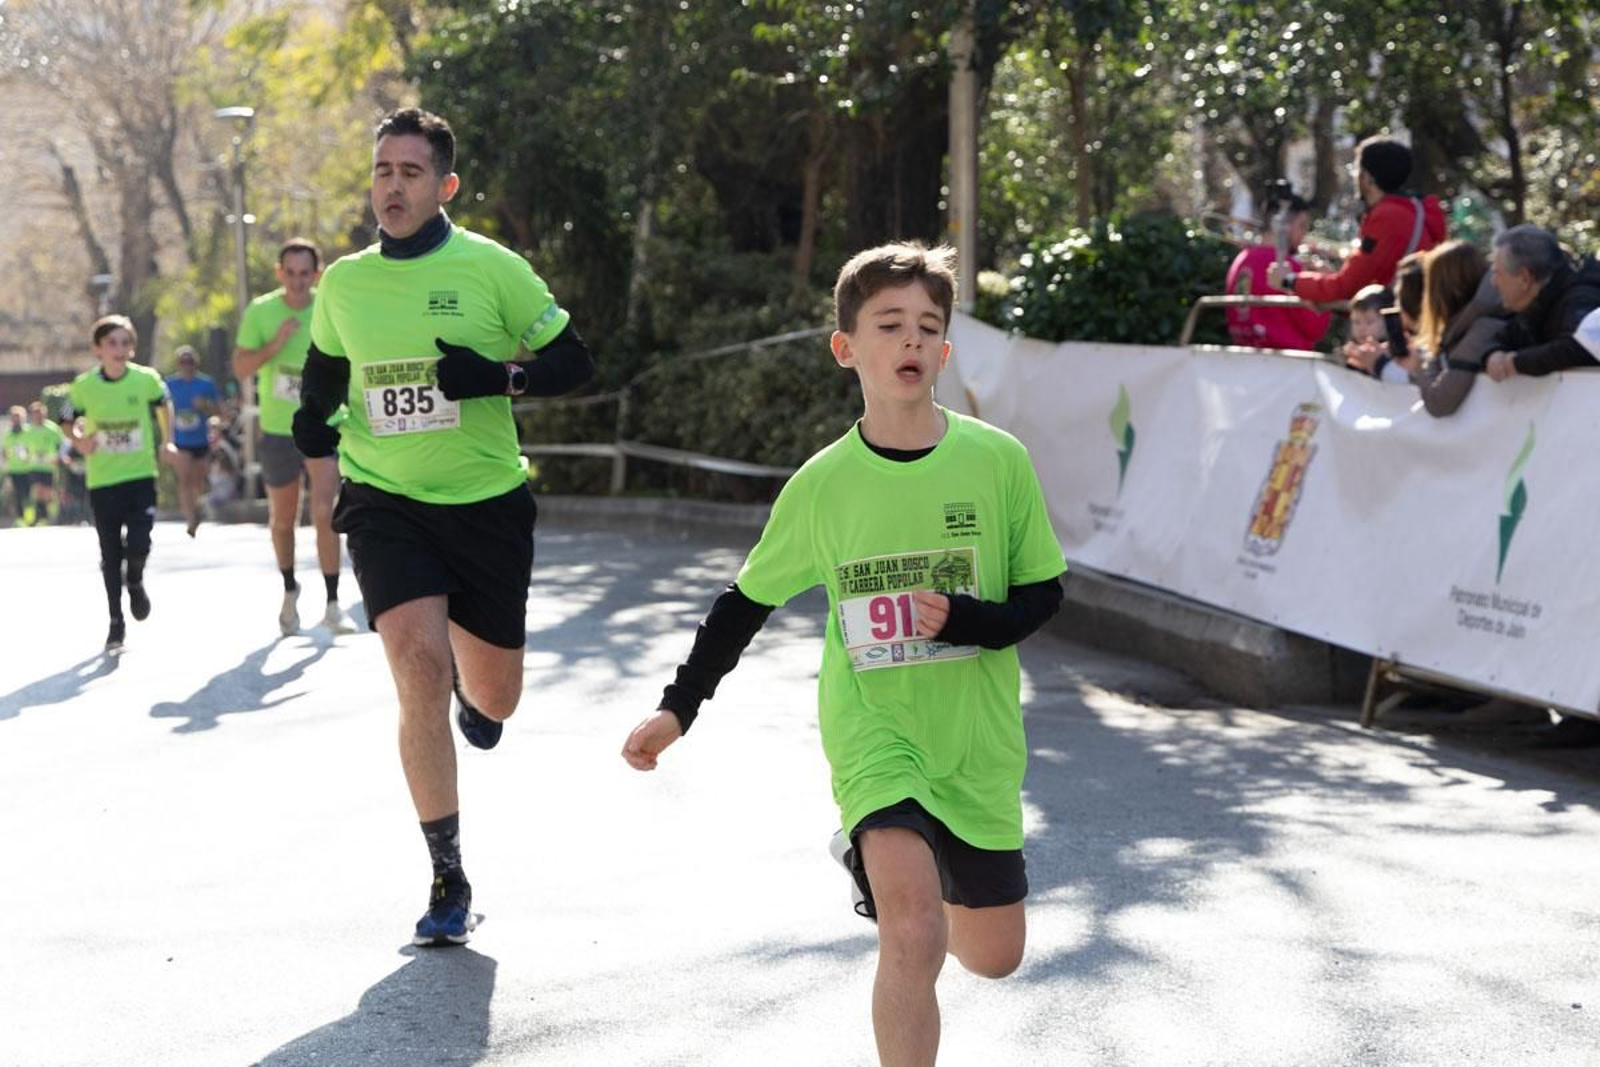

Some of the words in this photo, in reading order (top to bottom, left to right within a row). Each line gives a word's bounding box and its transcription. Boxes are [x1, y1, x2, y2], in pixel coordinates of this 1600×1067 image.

[383, 385, 435, 417] 835
[853, 562, 871, 579] SAN
[874, 559, 899, 576] JUAN
[901, 556, 930, 572] BOSCO
[849, 575, 886, 594] CARRERA
[887, 571, 924, 590] POPULAR
